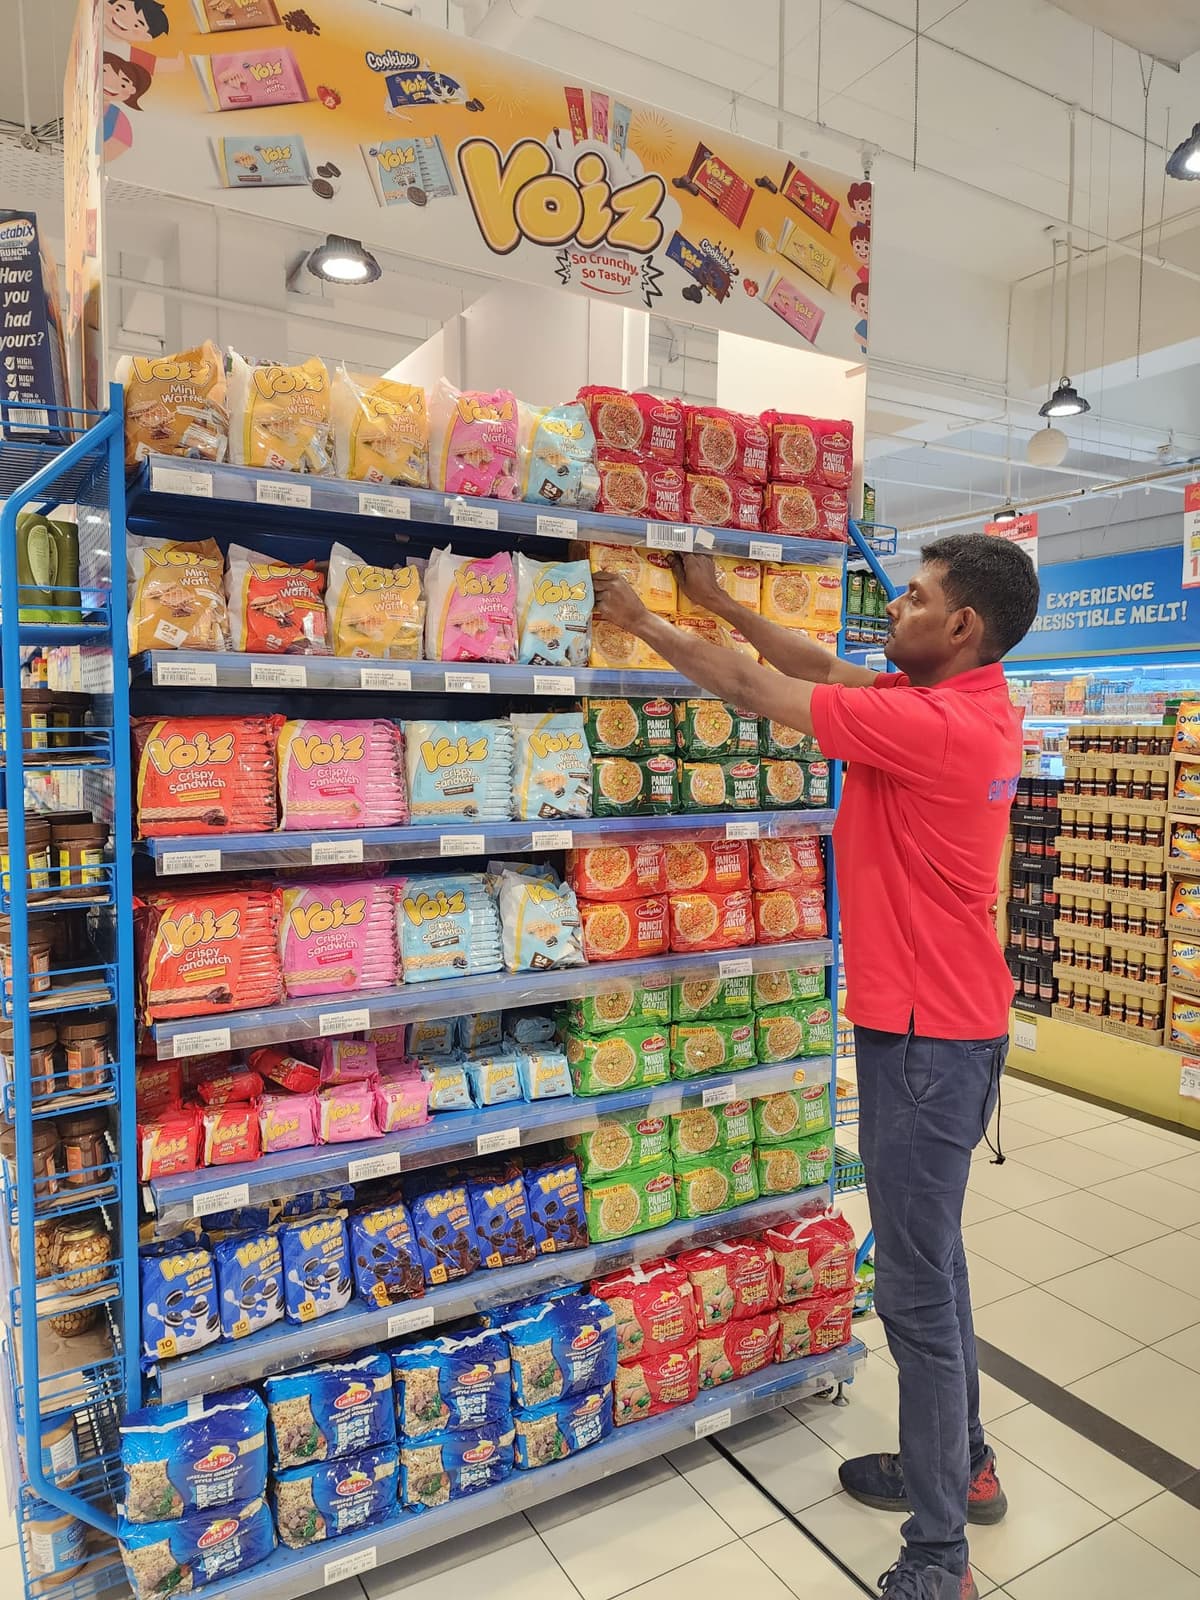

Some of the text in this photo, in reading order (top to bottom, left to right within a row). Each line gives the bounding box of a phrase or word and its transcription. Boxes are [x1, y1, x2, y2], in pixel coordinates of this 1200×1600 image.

[366, 50, 419, 71] Cookies
[456, 136, 668, 255] Voiz
[571, 253, 639, 276] So Crunchy,
[0, 267, 34, 284] Have
[582, 268, 631, 286] So Tasty!
[3, 290, 30, 307] you
[4, 311, 32, 327] had
[0, 332, 45, 351] yours?
[169, 384, 196, 395] Mini
[286, 404, 322, 417] Waffle
[487, 424, 507, 434] Mini
[653, 425, 677, 437] PANCIT
[481, 433, 513, 445] Waffle
[651, 437, 676, 450] CANTON
[744, 447, 767, 459] PANCIT
[823, 452, 845, 464] PANCIT
[271, 454, 286, 467] 24
[744, 457, 766, 468] CANTON
[369, 470, 384, 482] 24
[463, 481, 478, 492] 24
[544, 484, 557, 495] 24
[656, 491, 679, 503] PANCIT
[655, 501, 680, 513] CANTON
[185, 568, 208, 578] Mini
[346, 564, 418, 595] Voiz
[455, 569, 509, 597] Voiz
[380, 591, 401, 602] Mini
[533, 579, 586, 605] Voiz
[1046, 581, 1155, 610] EXPERIENCE
[374, 601, 409, 613] Waffle
[477, 604, 509, 615] Waffle
[559, 604, 578, 614] Mini
[554, 612, 585, 623] Waffle
[1029, 600, 1188, 632] RESISTIBLE MELT!
[161, 624, 178, 637] 24
[266, 634, 282, 646] 24
[646, 719, 670, 731] PANCIT
[739, 721, 758, 732] PANCIT
[647, 728, 670, 739] CANTON
[739, 730, 758, 741] CANTON
[291, 733, 367, 770] Voiz
[528, 732, 584, 759] Voiz
[148, 732, 235, 775] Voiz
[420, 736, 489, 773] Voiz
[560, 753, 577, 761] Mini
[178, 770, 214, 783] Crispy
[317, 767, 350, 779] Crispy
[441, 767, 474, 779] Crispy
[169, 779, 226, 795] Sandwich
[309, 776, 360, 790] Sandwich
[434, 776, 480, 791] Sandwich
[651, 775, 673, 787] PANCIT
[734, 780, 756, 792] PANCIT
[651, 784, 673, 795] CANTON
[734, 788, 758, 799] CANTON
[638, 855, 658, 867] PANCIT
[715, 854, 740, 865] PANCIT
[715, 862, 741, 873] CANTON
[403, 889, 466, 926] Voiz
[290, 898, 367, 940] Voiz
[638, 919, 662, 931] PANCIT
[161, 909, 241, 956] Voiz
[422, 927, 466, 944] Sandwich
[638, 929, 662, 940] CANTON
[315, 933, 348, 946] Crispy
[185, 947, 221, 962] Crispy
[307, 939, 358, 959] Sandwich
[177, 956, 232, 976] Sandwich
[535, 955, 548, 966] 24
[726, 978, 749, 989] PANCIT
[643, 992, 667, 1002] PANCIT
[725, 987, 749, 997] CANTON
[727, 1117, 747, 1130] PANCIT
[649, 1190, 671, 1205] PANCIT
[301, 1217, 343, 1250] Voiz
[321, 1237, 344, 1254] BITS
[543, 1241, 553, 1249] 10
[236, 1235, 279, 1268] Voiz
[259, 1252, 281, 1271] BITS
[489, 1256, 499, 1265] 10
[186, 1267, 211, 1286] BITS
[433, 1268, 443, 1278] 10
[301, 1302, 312, 1313] 10
[236, 1321, 247, 1331] 10
[160, 1339, 173, 1351] 10
[338, 1415, 370, 1433] Beef
